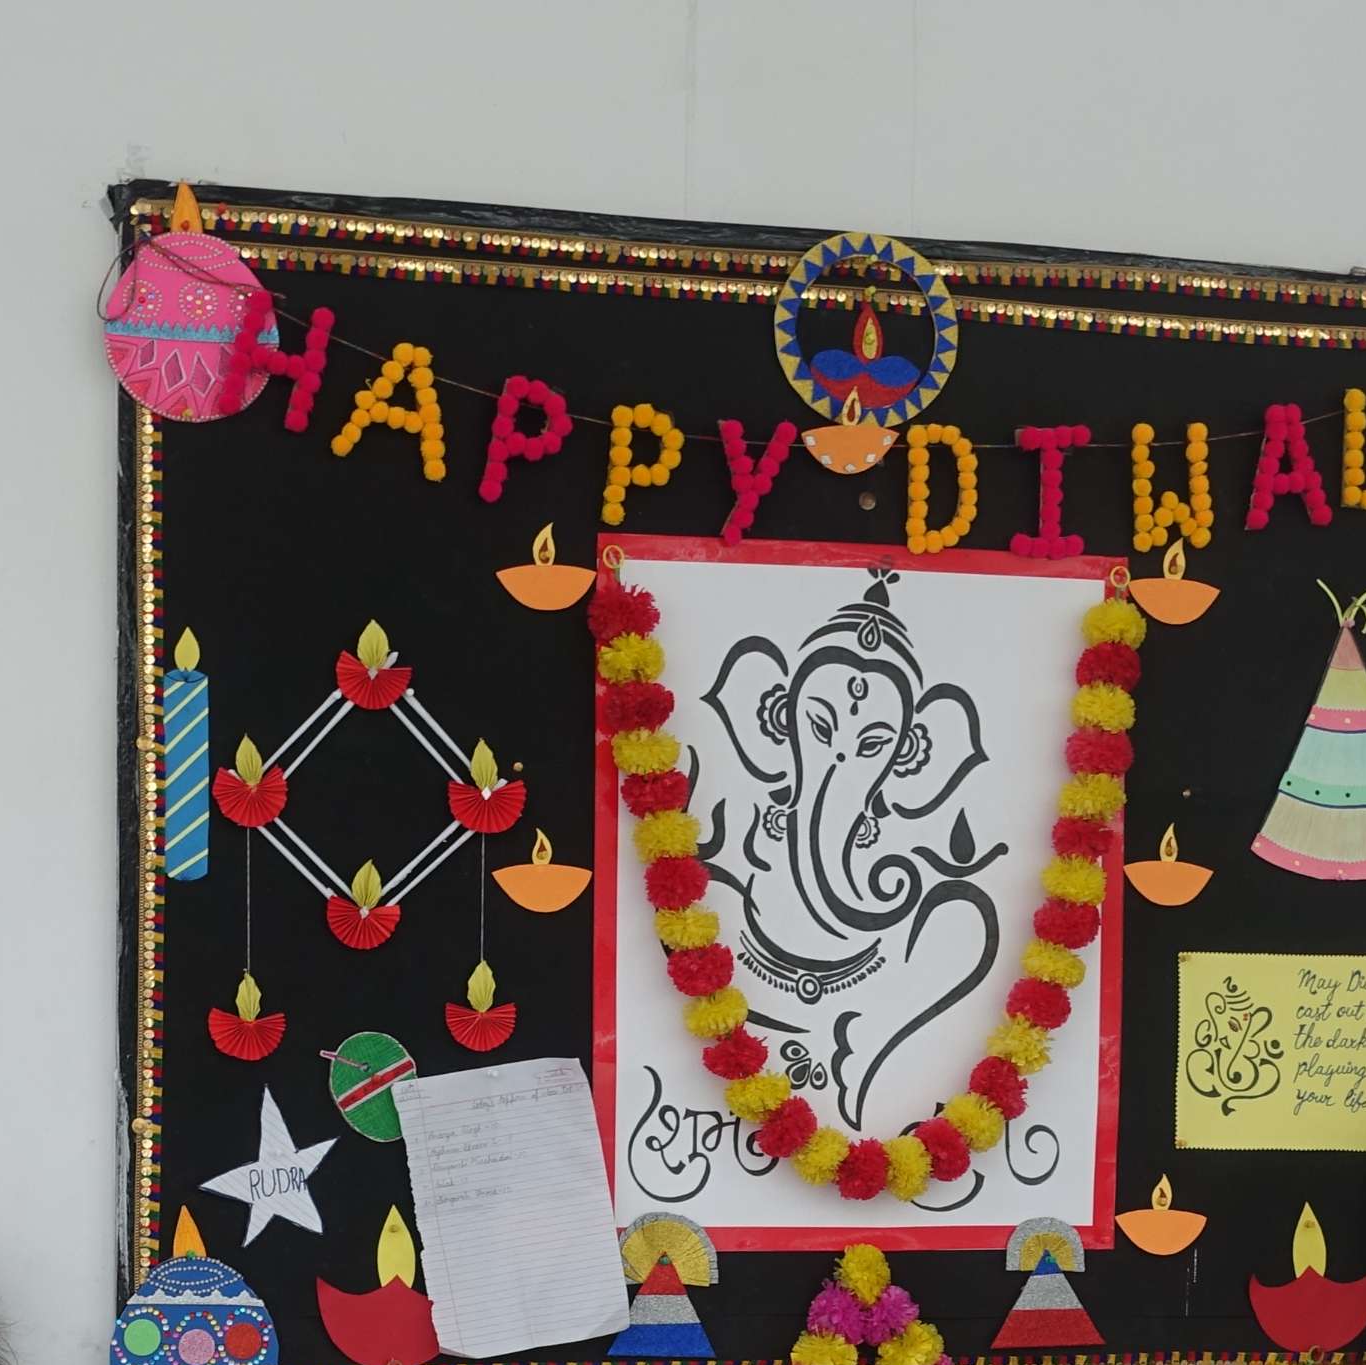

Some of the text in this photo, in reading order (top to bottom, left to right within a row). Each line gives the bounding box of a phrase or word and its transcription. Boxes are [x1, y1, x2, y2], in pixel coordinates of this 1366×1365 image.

[219, 291, 797, 547] HAPPY
[1298, 968, 1340, 995] May
[1296, 999, 1331, 1022] cast
[1337, 1002, 1365, 1021] out
[1293, 1023, 1324, 1050] the
[1292, 1089, 1335, 1116] your
[248, 1166, 308, 1202] RUDRA
